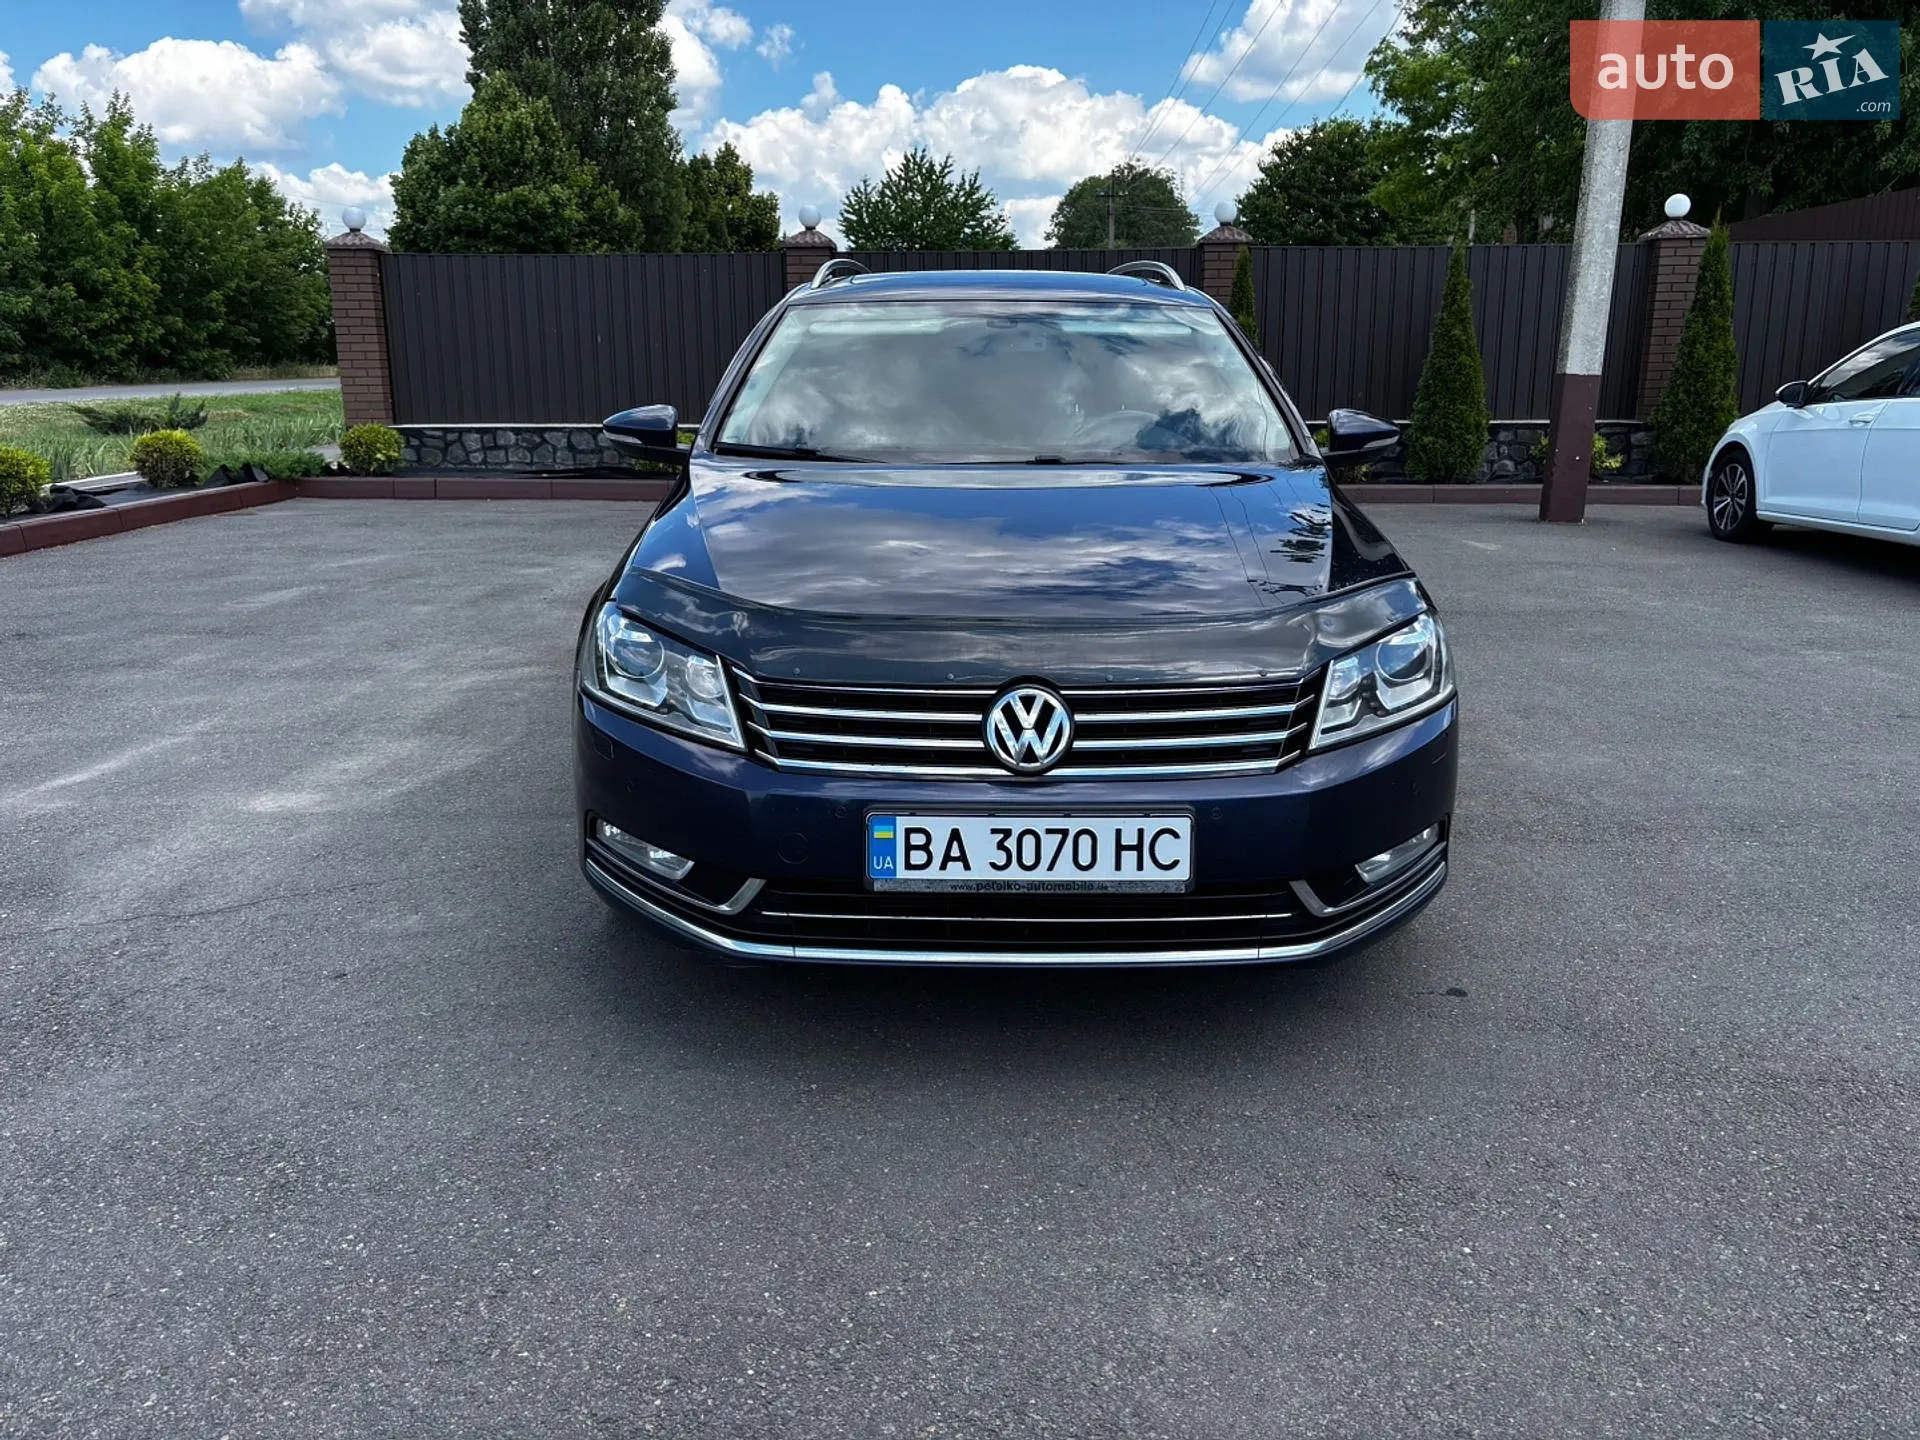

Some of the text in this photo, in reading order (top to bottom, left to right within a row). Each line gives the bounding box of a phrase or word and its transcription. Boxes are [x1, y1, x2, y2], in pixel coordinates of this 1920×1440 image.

[873, 855, 894, 870] UA
[903, 827, 1181, 872] BA 3070 HC
